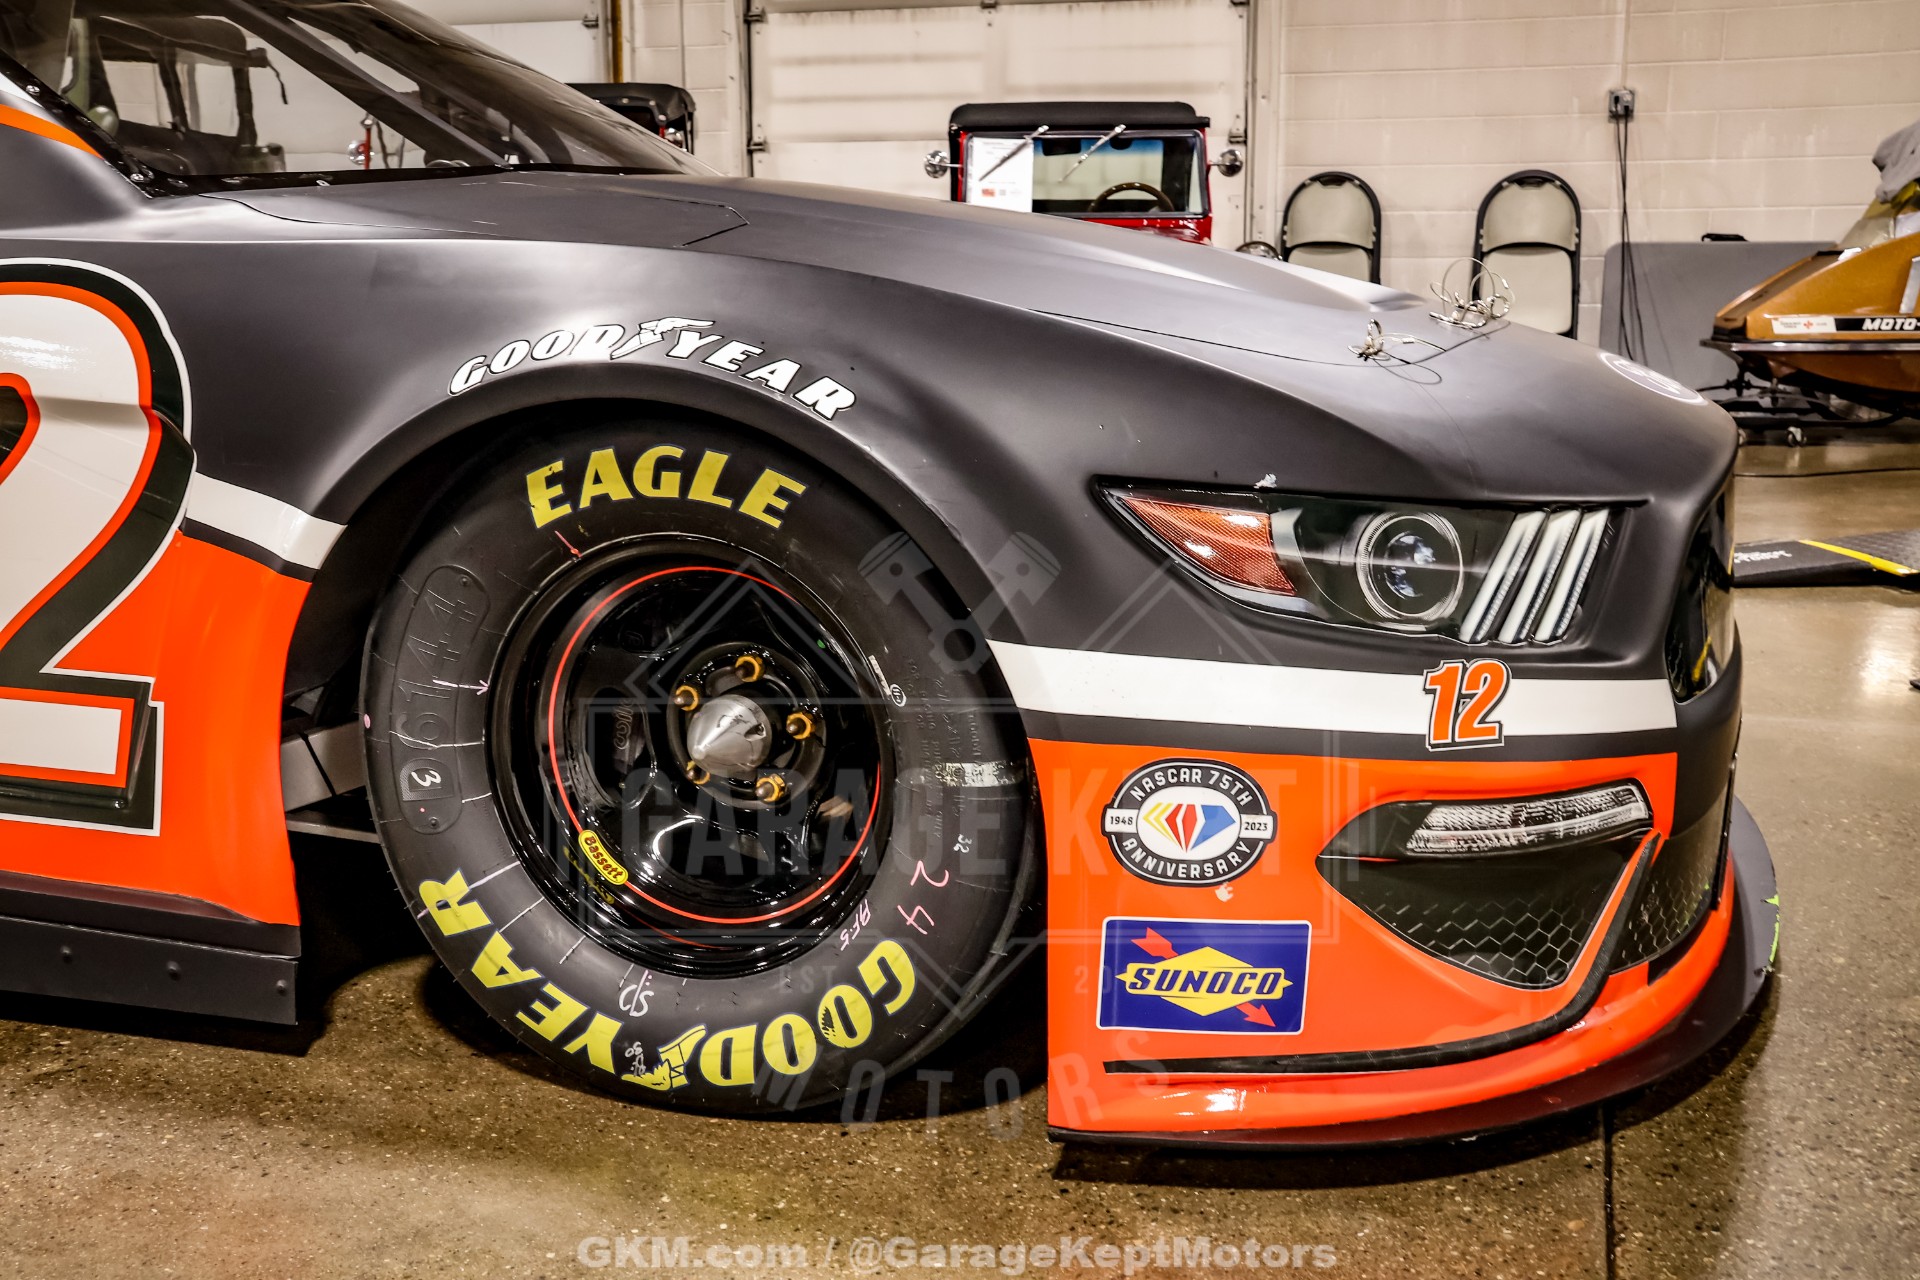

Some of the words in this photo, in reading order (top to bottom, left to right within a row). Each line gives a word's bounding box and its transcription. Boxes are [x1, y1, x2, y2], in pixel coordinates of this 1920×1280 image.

[447, 317, 857, 421] GOODYEAR
[525, 444, 808, 529] EAGLE
[1424, 659, 1511, 750] 12
[1130, 768, 1202, 801] NASCAR
[1208, 770, 1253, 806] 75TH
[1110, 816, 1133, 825] 1948
[1244, 821, 1268, 831] 2023
[585, 836, 624, 879] Bassett
[1122, 837, 1251, 878] ANNIVERSARY
[419, 868, 917, 1091] GOODYEAR
[1129, 967, 1282, 996] SUNOCO
